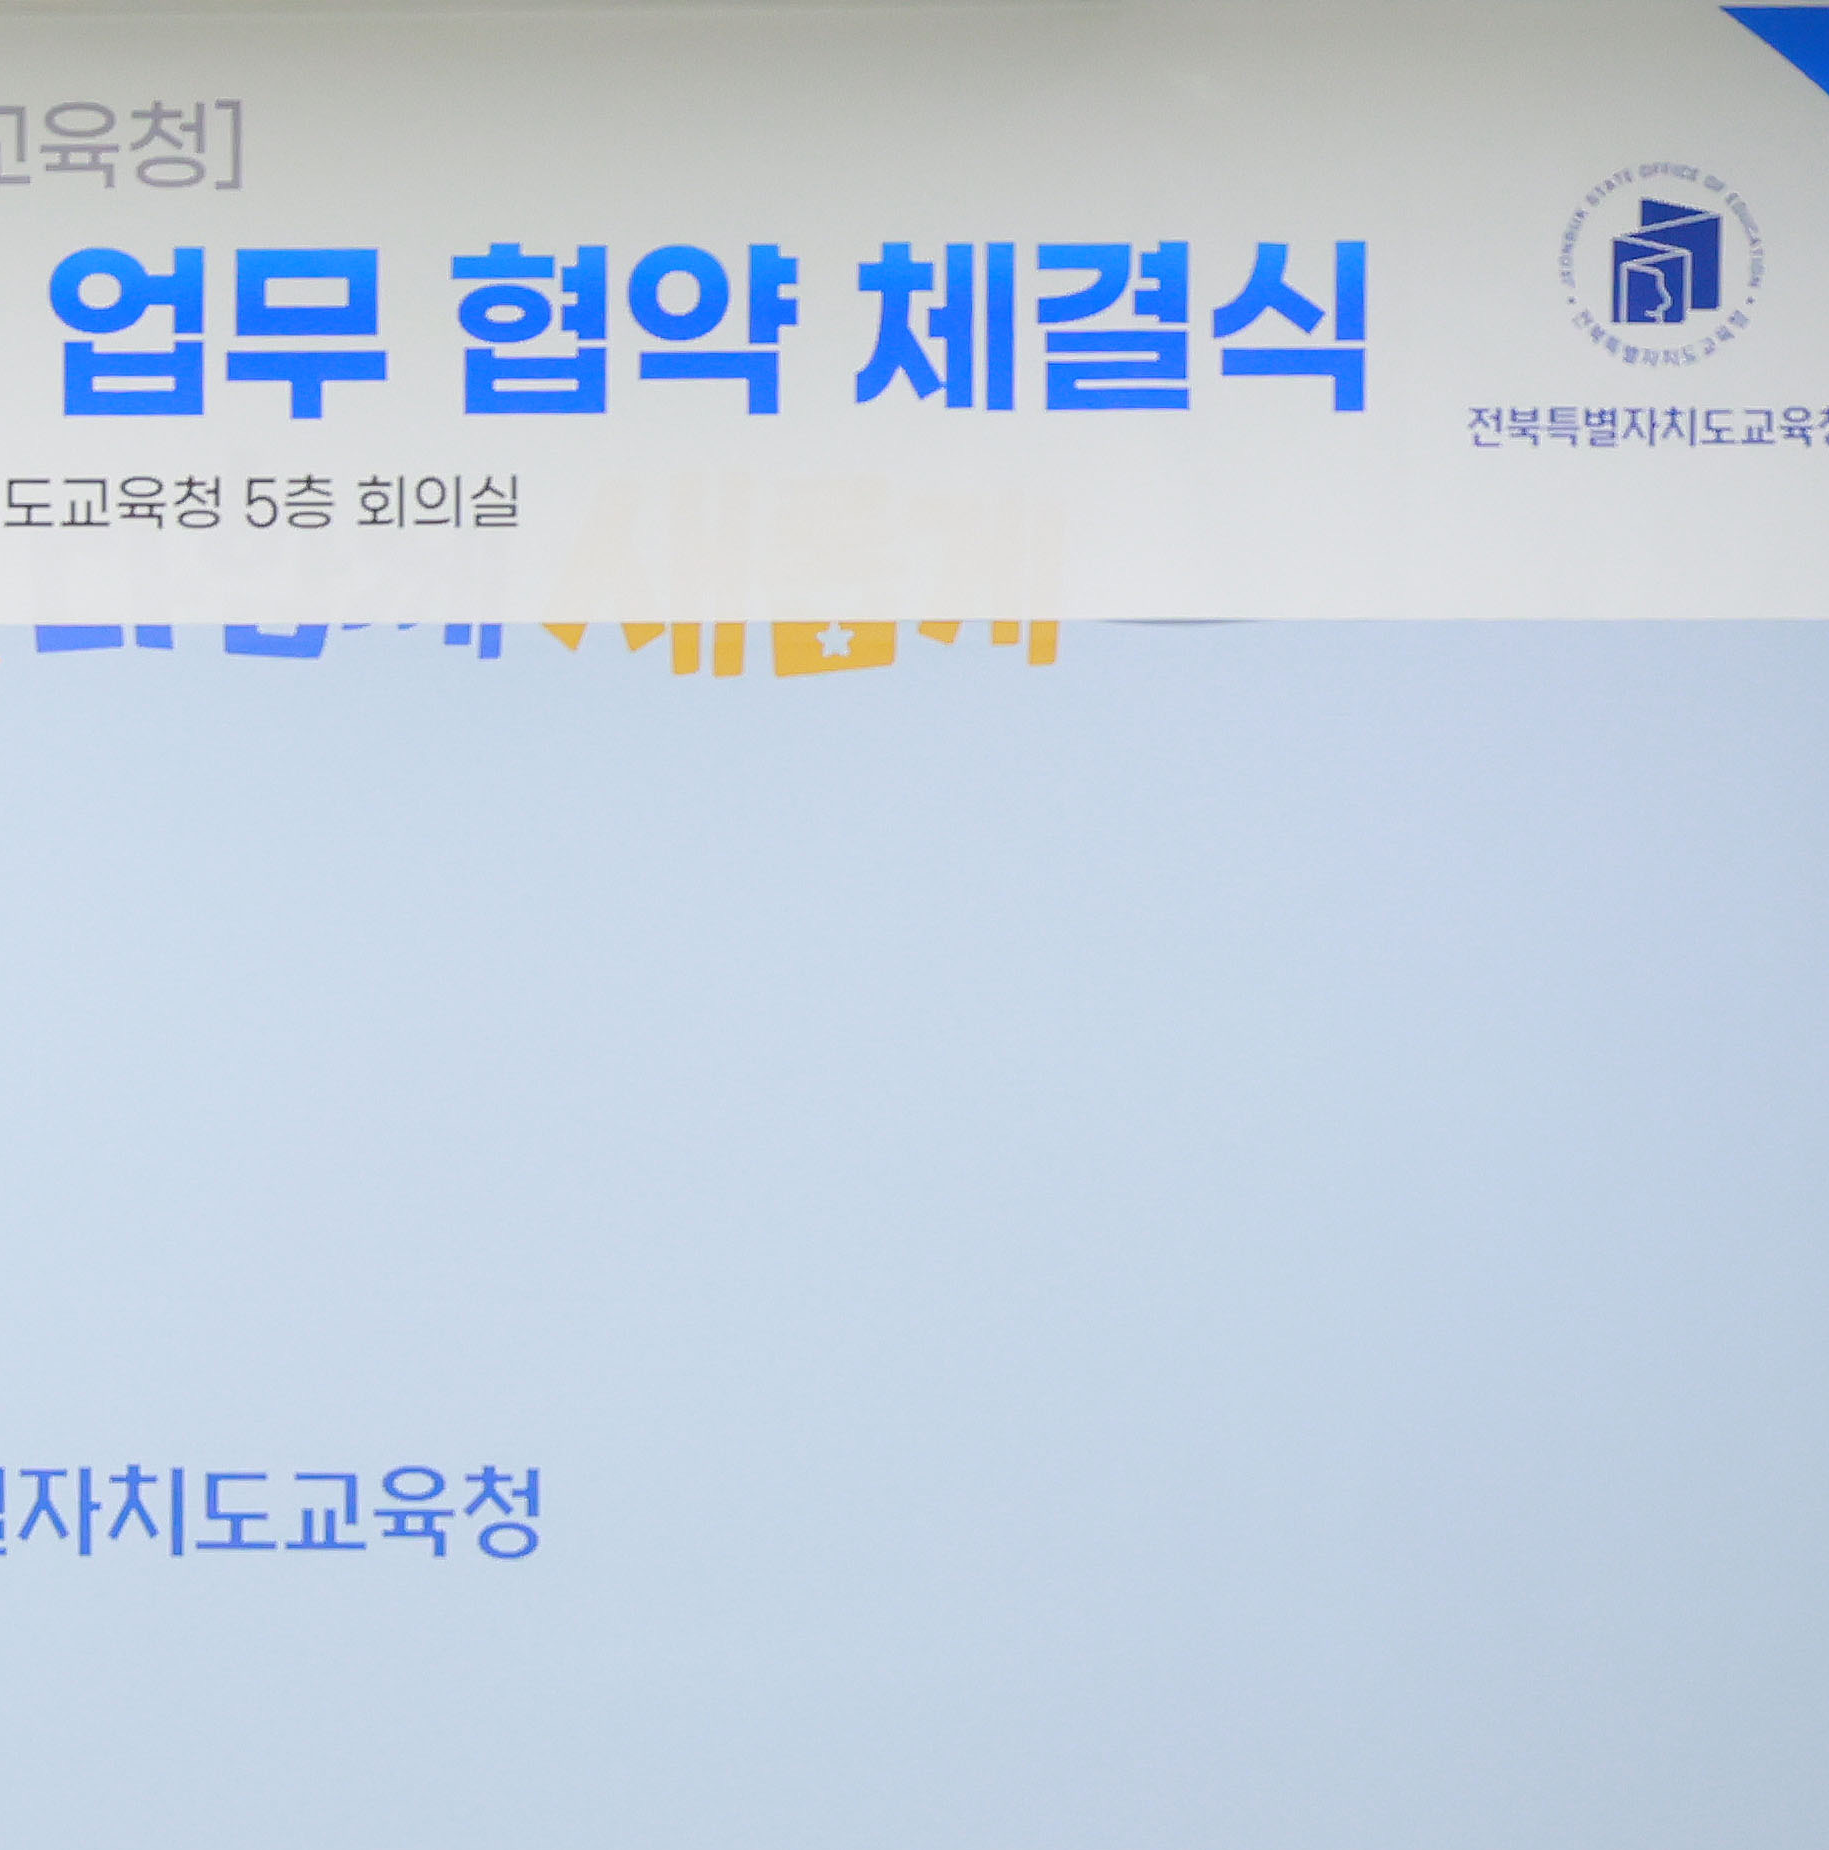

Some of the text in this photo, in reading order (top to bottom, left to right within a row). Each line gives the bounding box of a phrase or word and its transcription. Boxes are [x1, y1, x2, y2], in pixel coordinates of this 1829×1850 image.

[49, 246, 390, 421] 업무
[451, 243, 801, 417] 협약
[855, 240, 1370, 414] 체결식
[247, 475, 335, 530] 5층
[359, 476, 519, 529] 회의실
